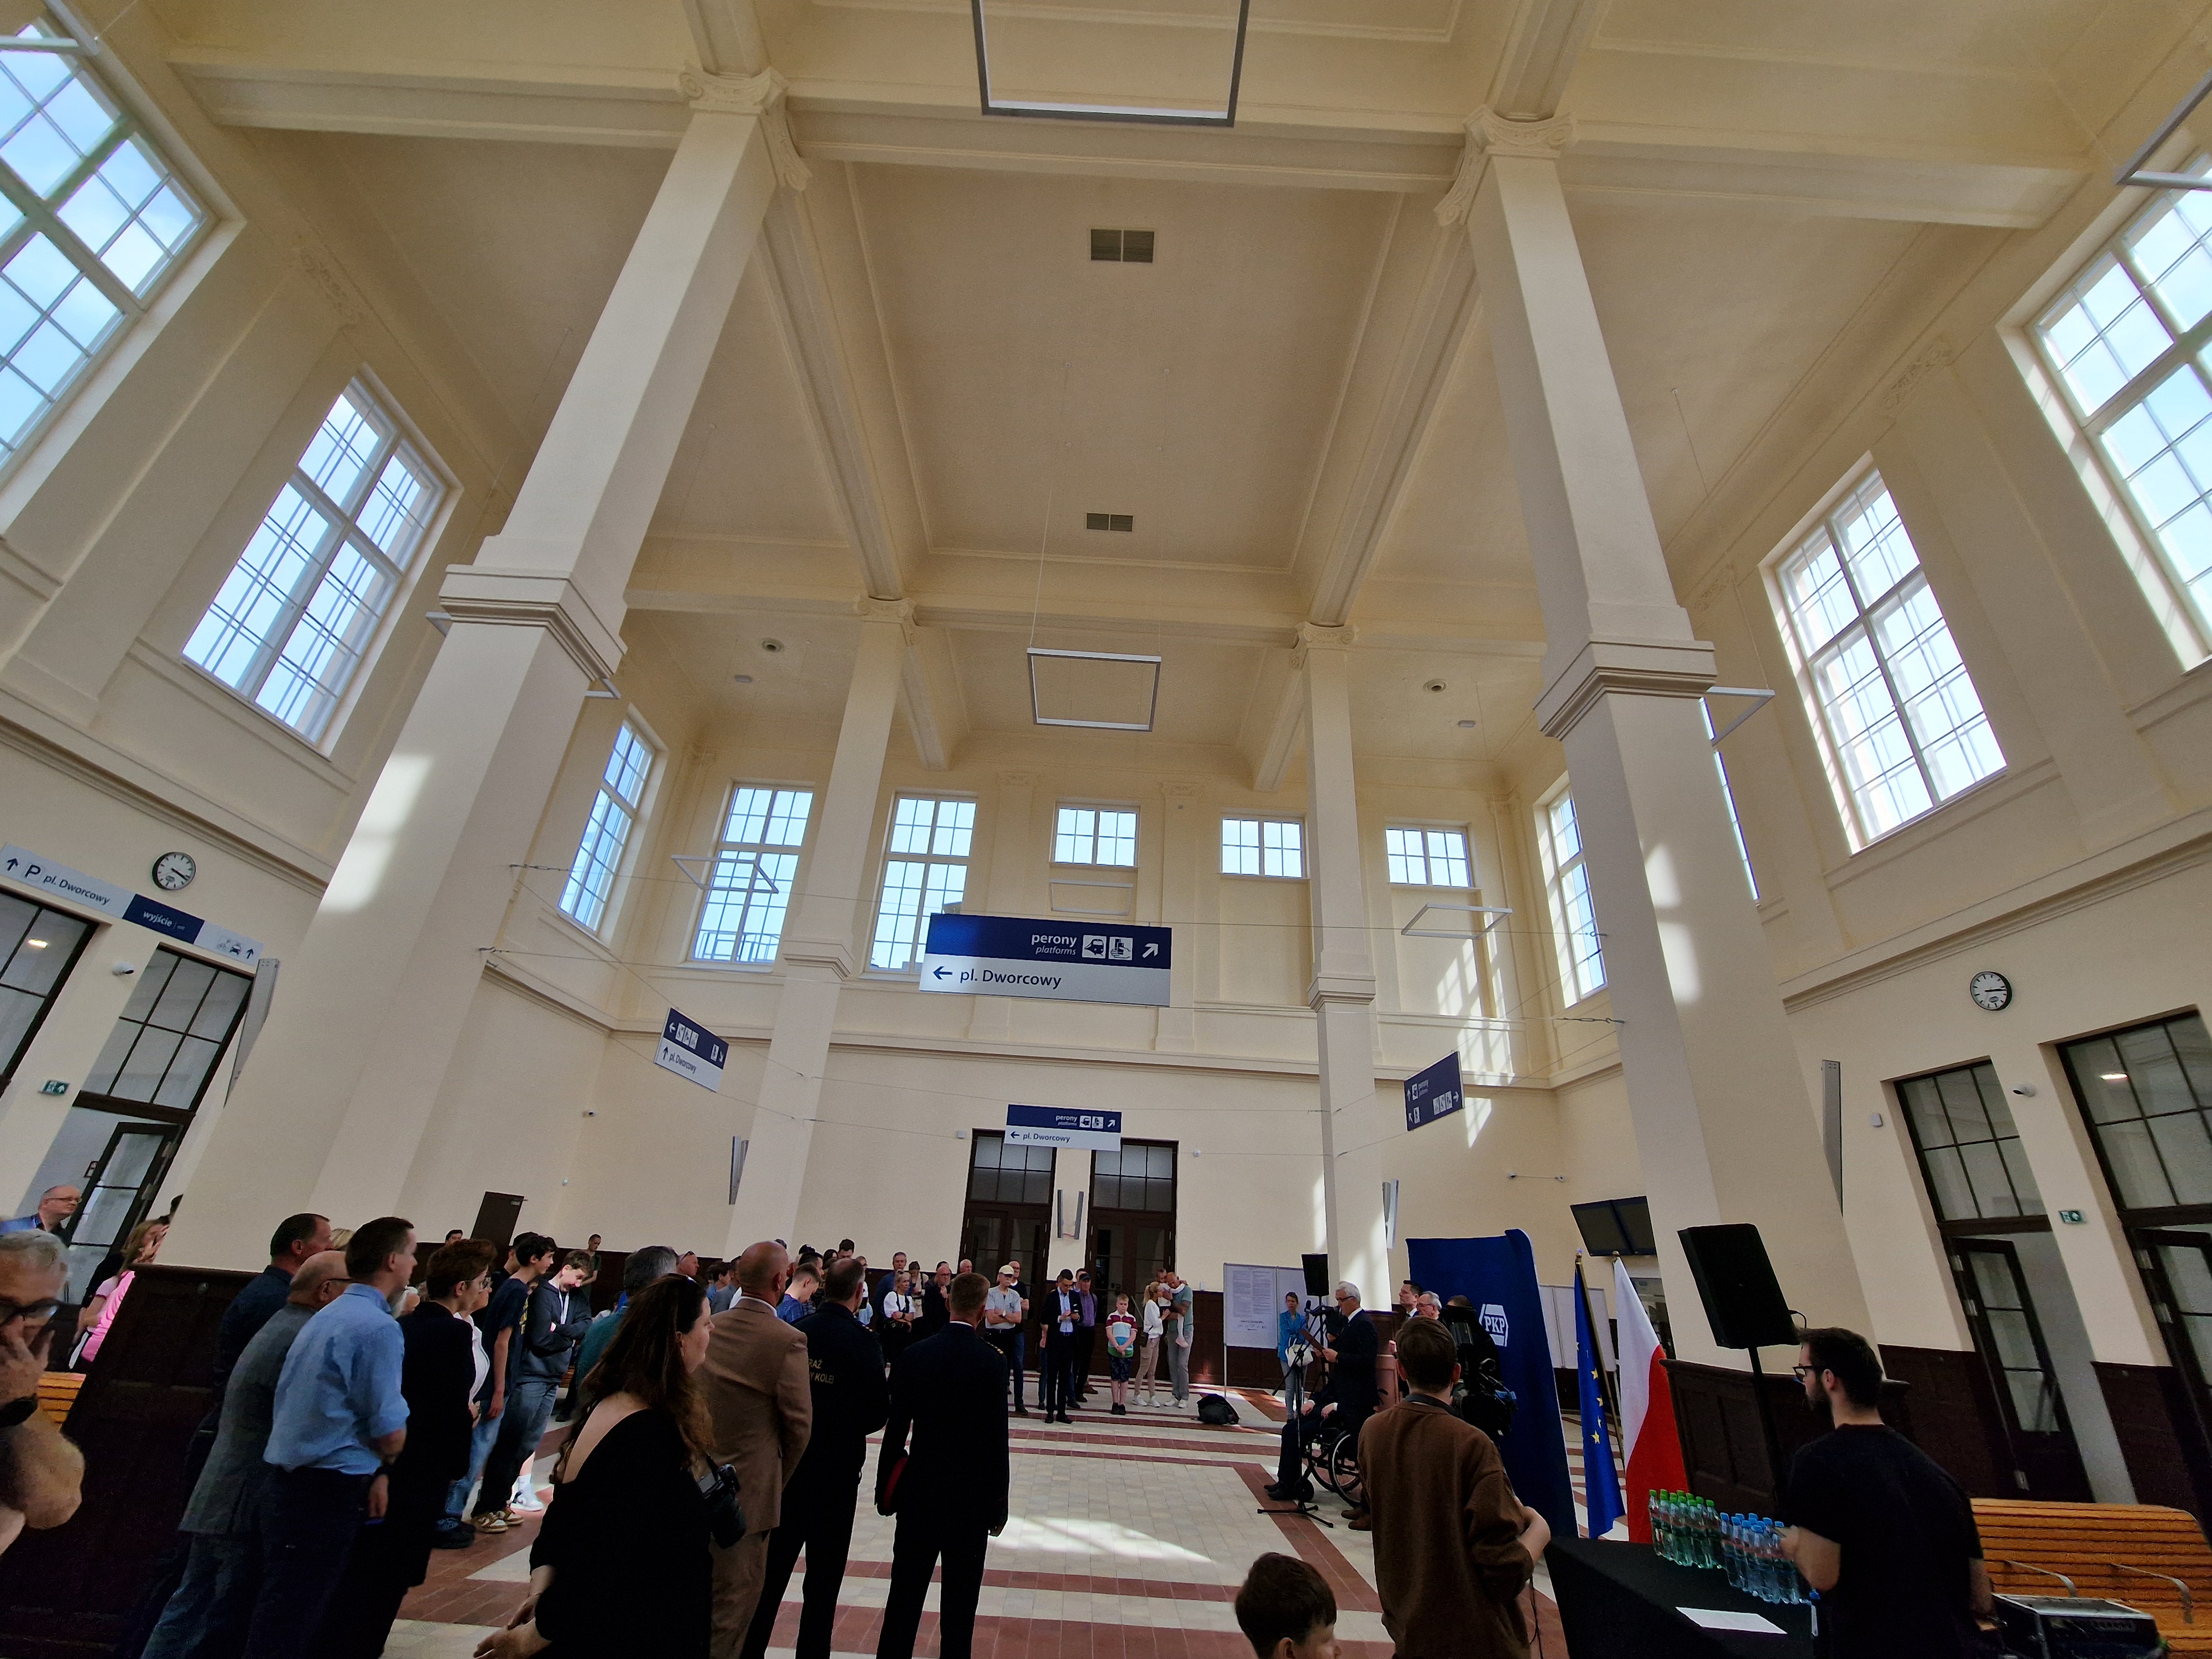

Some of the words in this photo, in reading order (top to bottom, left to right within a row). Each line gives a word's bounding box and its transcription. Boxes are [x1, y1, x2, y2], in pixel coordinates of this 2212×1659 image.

[24, 864, 41, 878] P
[43, 875, 56, 885] pl.
[59, 879, 111, 905] Dworcowy
[143, 911, 173, 927] wyjście
[1031, 935, 1077, 947] perony
[1035, 945, 1077, 955] platforms
[960, 968, 978, 983] pl.
[983, 970, 1062, 990] Dworcowy
[675, 1055, 697, 1074] Dworcowy
[1033, 1133, 1071, 1143] Dworcowy
[1484, 1316, 1505, 1334] PKP
[808, 1358, 822, 1369] RAŻ
